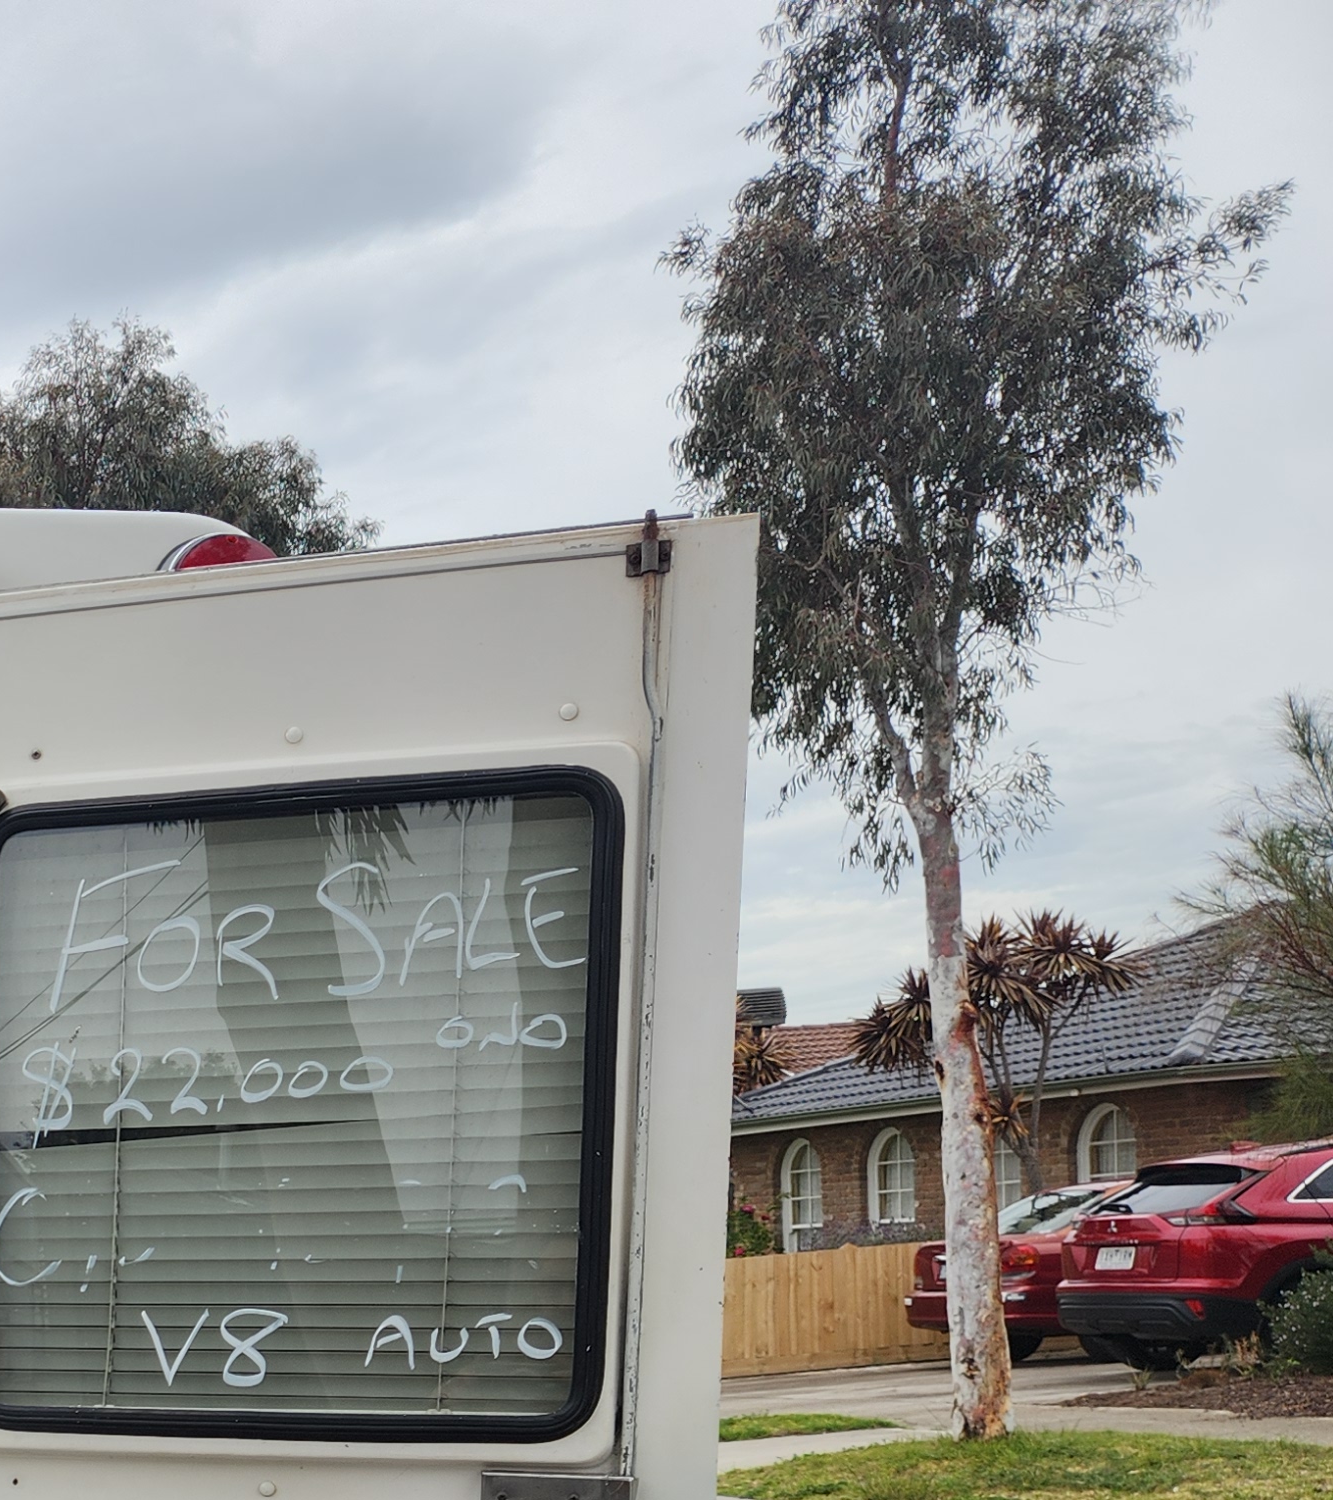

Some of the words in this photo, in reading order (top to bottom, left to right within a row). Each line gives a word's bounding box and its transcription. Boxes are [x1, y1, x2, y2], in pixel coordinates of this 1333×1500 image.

[50, 860, 278, 1013] FOR
[316, 862, 586, 995] SALE
[23, 1041, 393, 1149] $22,000
[141, 1307, 288, 1386] V8
[364, 1313, 562, 1370] AUTO
